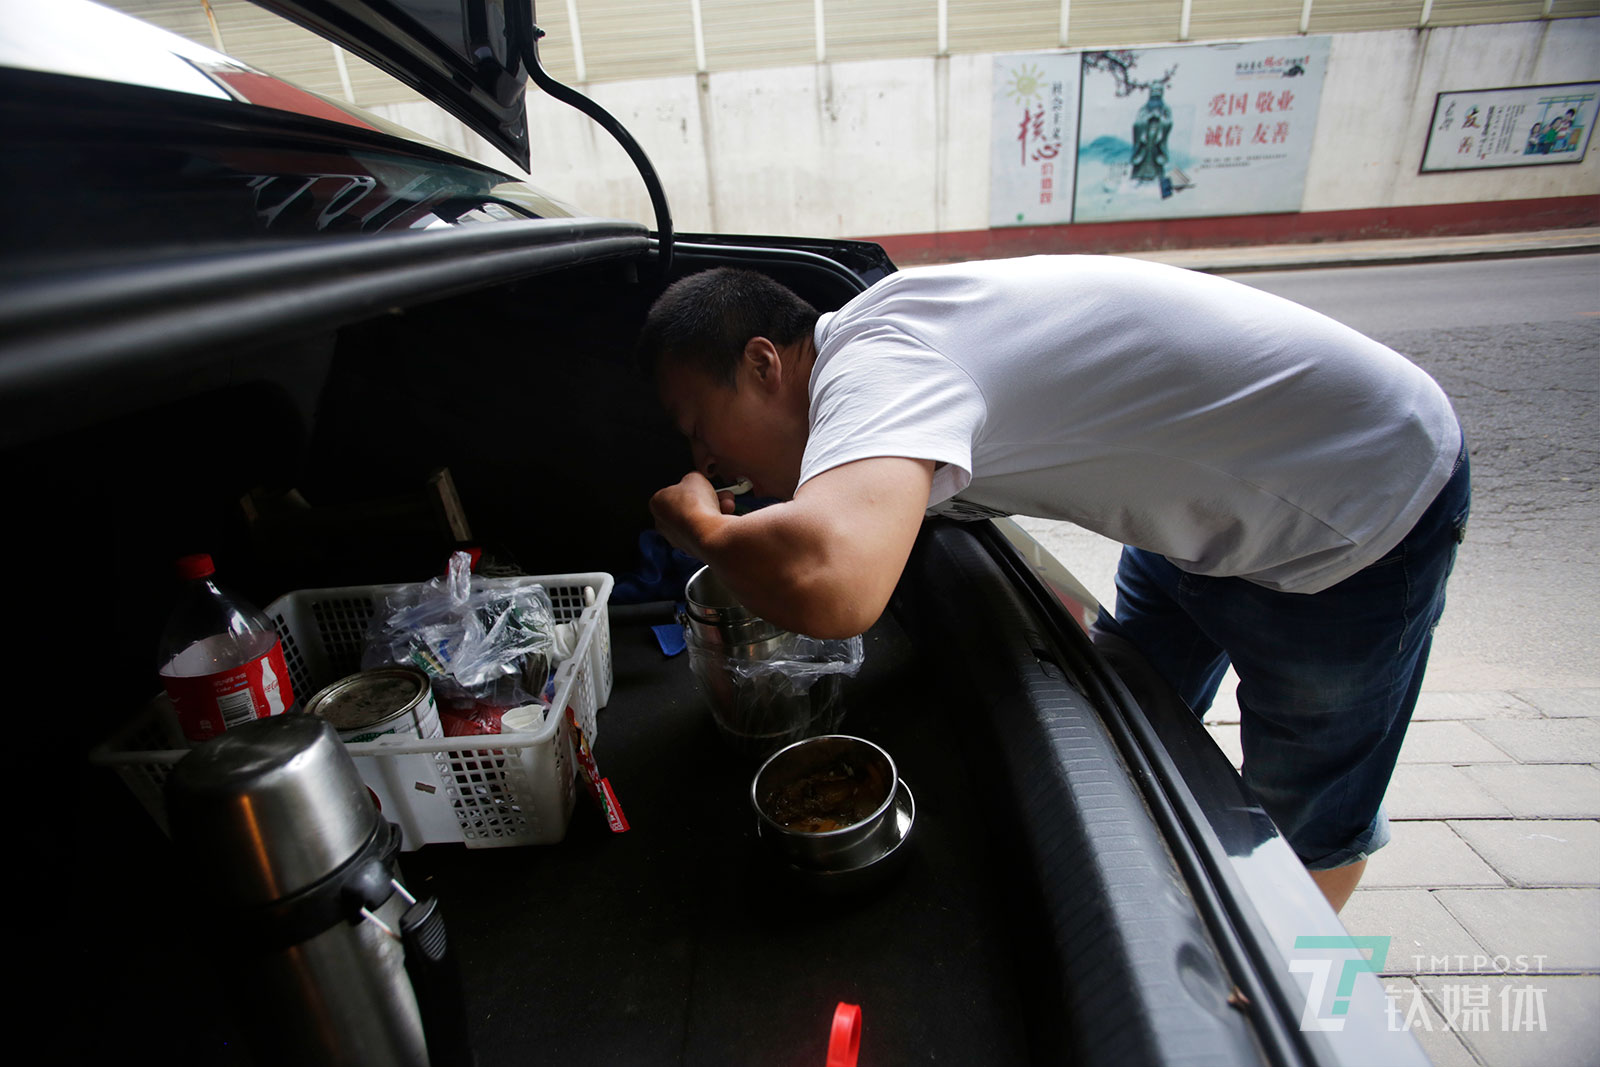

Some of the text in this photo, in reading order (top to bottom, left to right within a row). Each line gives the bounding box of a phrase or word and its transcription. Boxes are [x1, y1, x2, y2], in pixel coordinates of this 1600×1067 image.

[1208, 89, 1295, 117] 爱国 敬业
[1017, 104, 1062, 167] 核心
[1204, 121, 1290, 148] 诚信 友善
